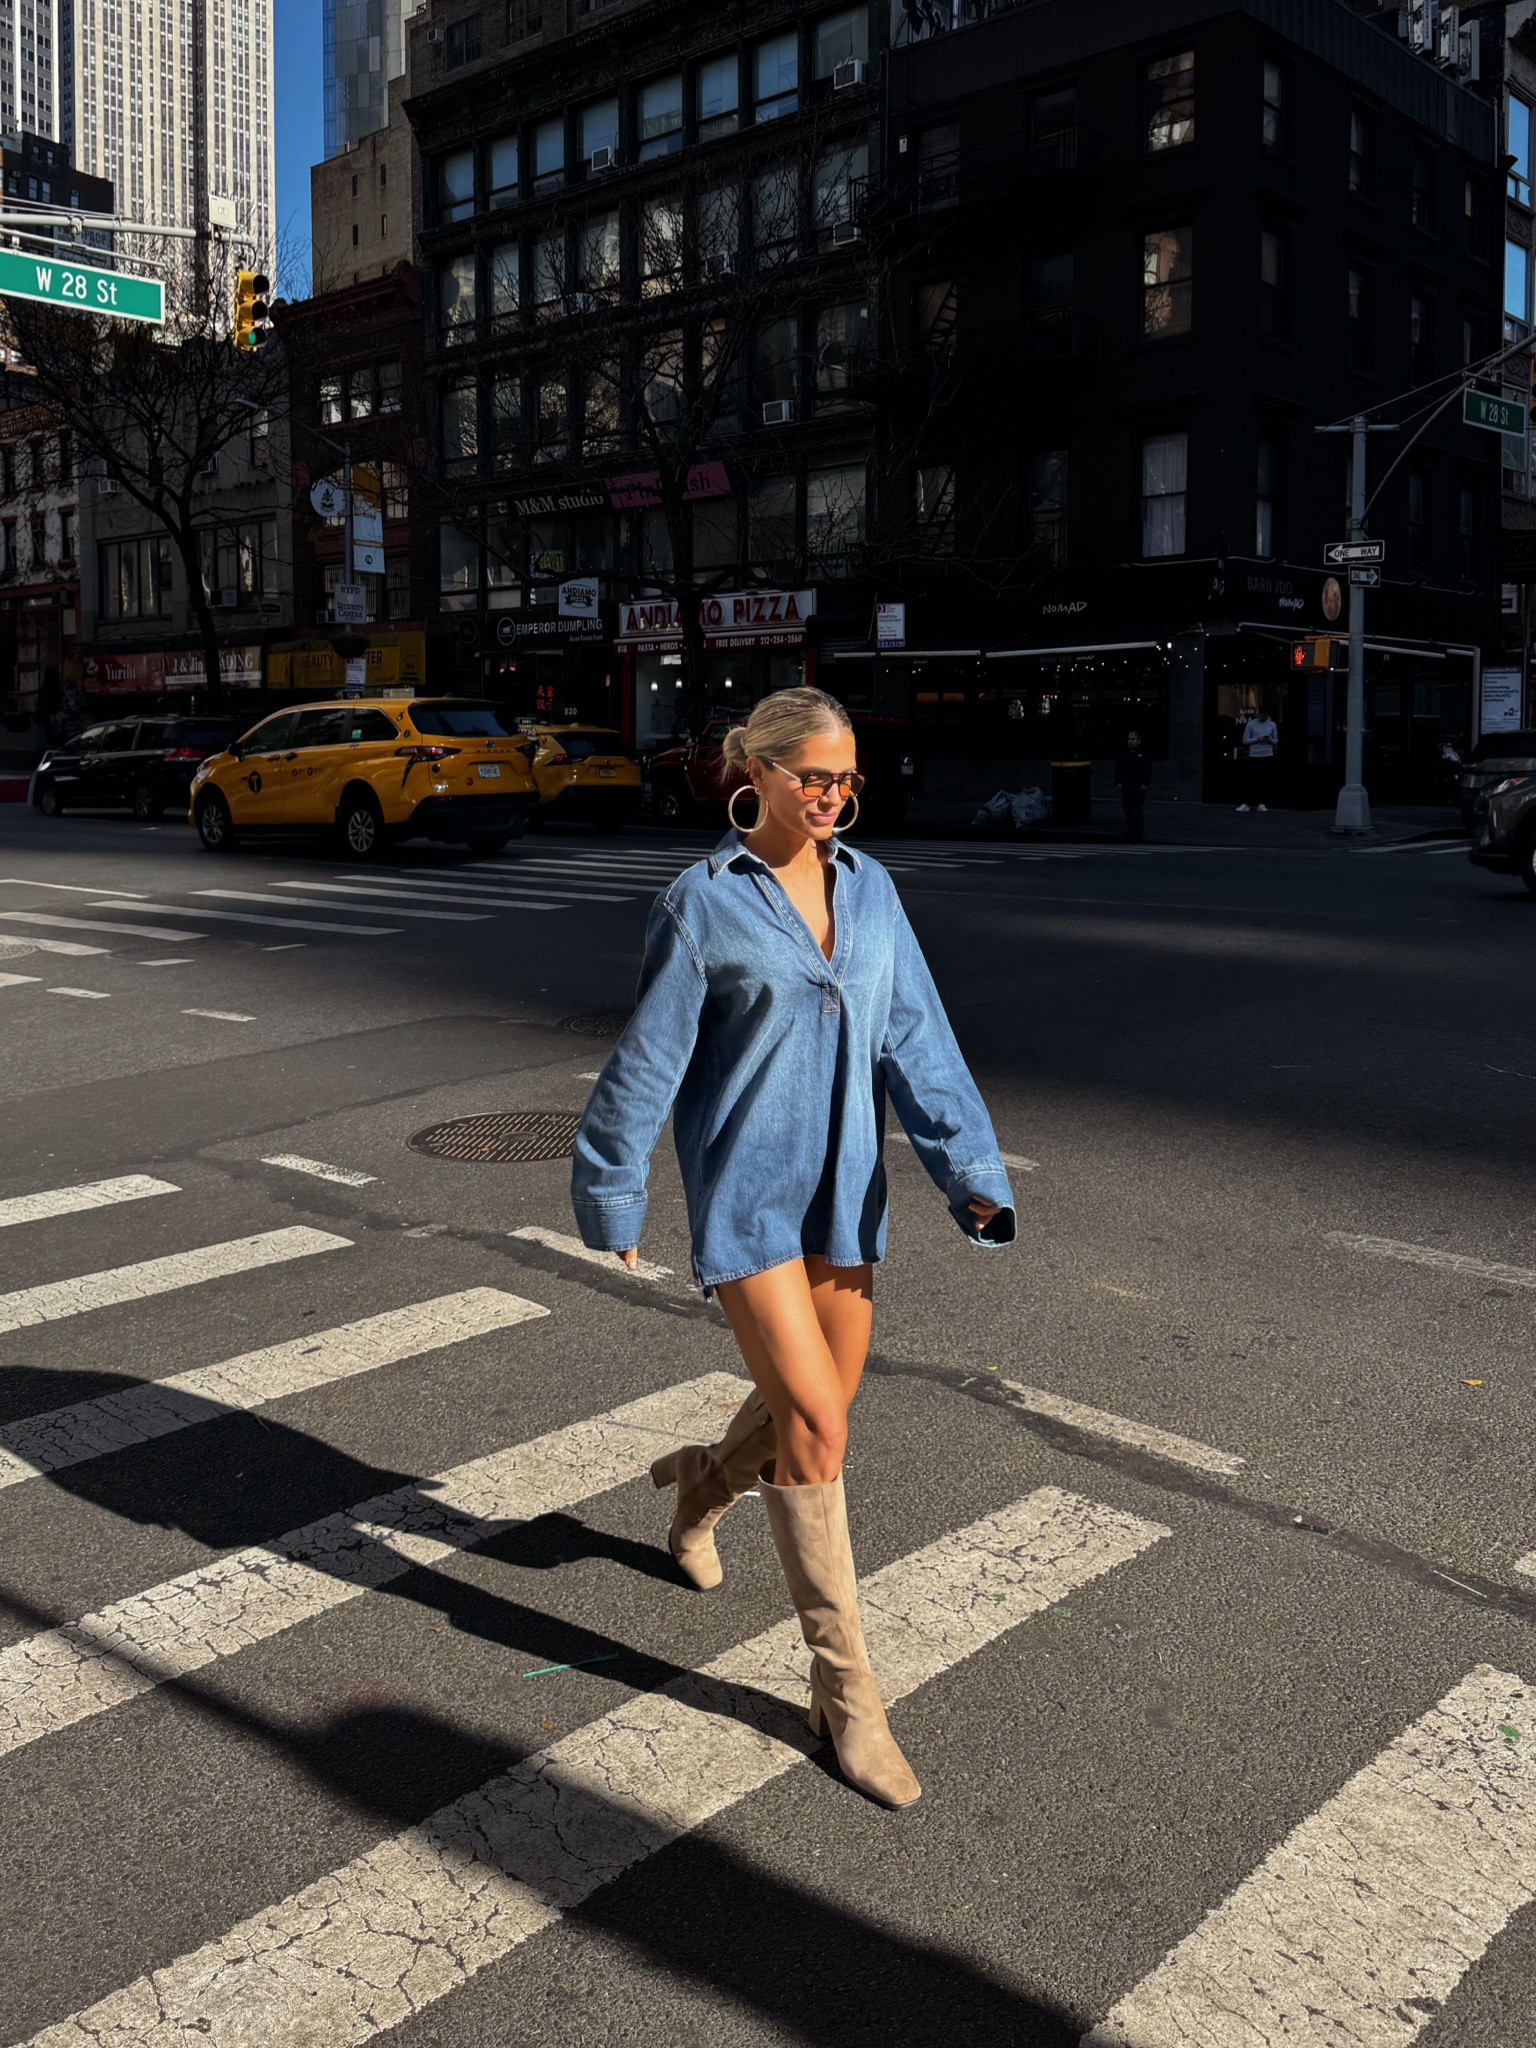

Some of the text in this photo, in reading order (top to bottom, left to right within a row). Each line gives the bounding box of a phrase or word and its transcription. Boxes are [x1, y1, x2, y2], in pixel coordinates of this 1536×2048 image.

[36, 266, 117, 305] W 28 St
[1481, 400, 1509, 426] W 28 St
[514, 488, 604, 516] M&M studio
[1366, 572, 1375, 580] WAY
[341, 586, 360, 594] NYPD
[562, 586, 597, 597] ANDIAMO
[1247, 576, 1293, 596] BARN JOO
[733, 594, 799, 624] PIZZA
[516, 618, 603, 636] EMPEROR DUMPLING
[637, 643, 655, 652] PASTA
[660, 641, 678, 650] HEROS
[716, 639, 728, 648] FREE
[730, 637, 755, 648] DELIVERY
